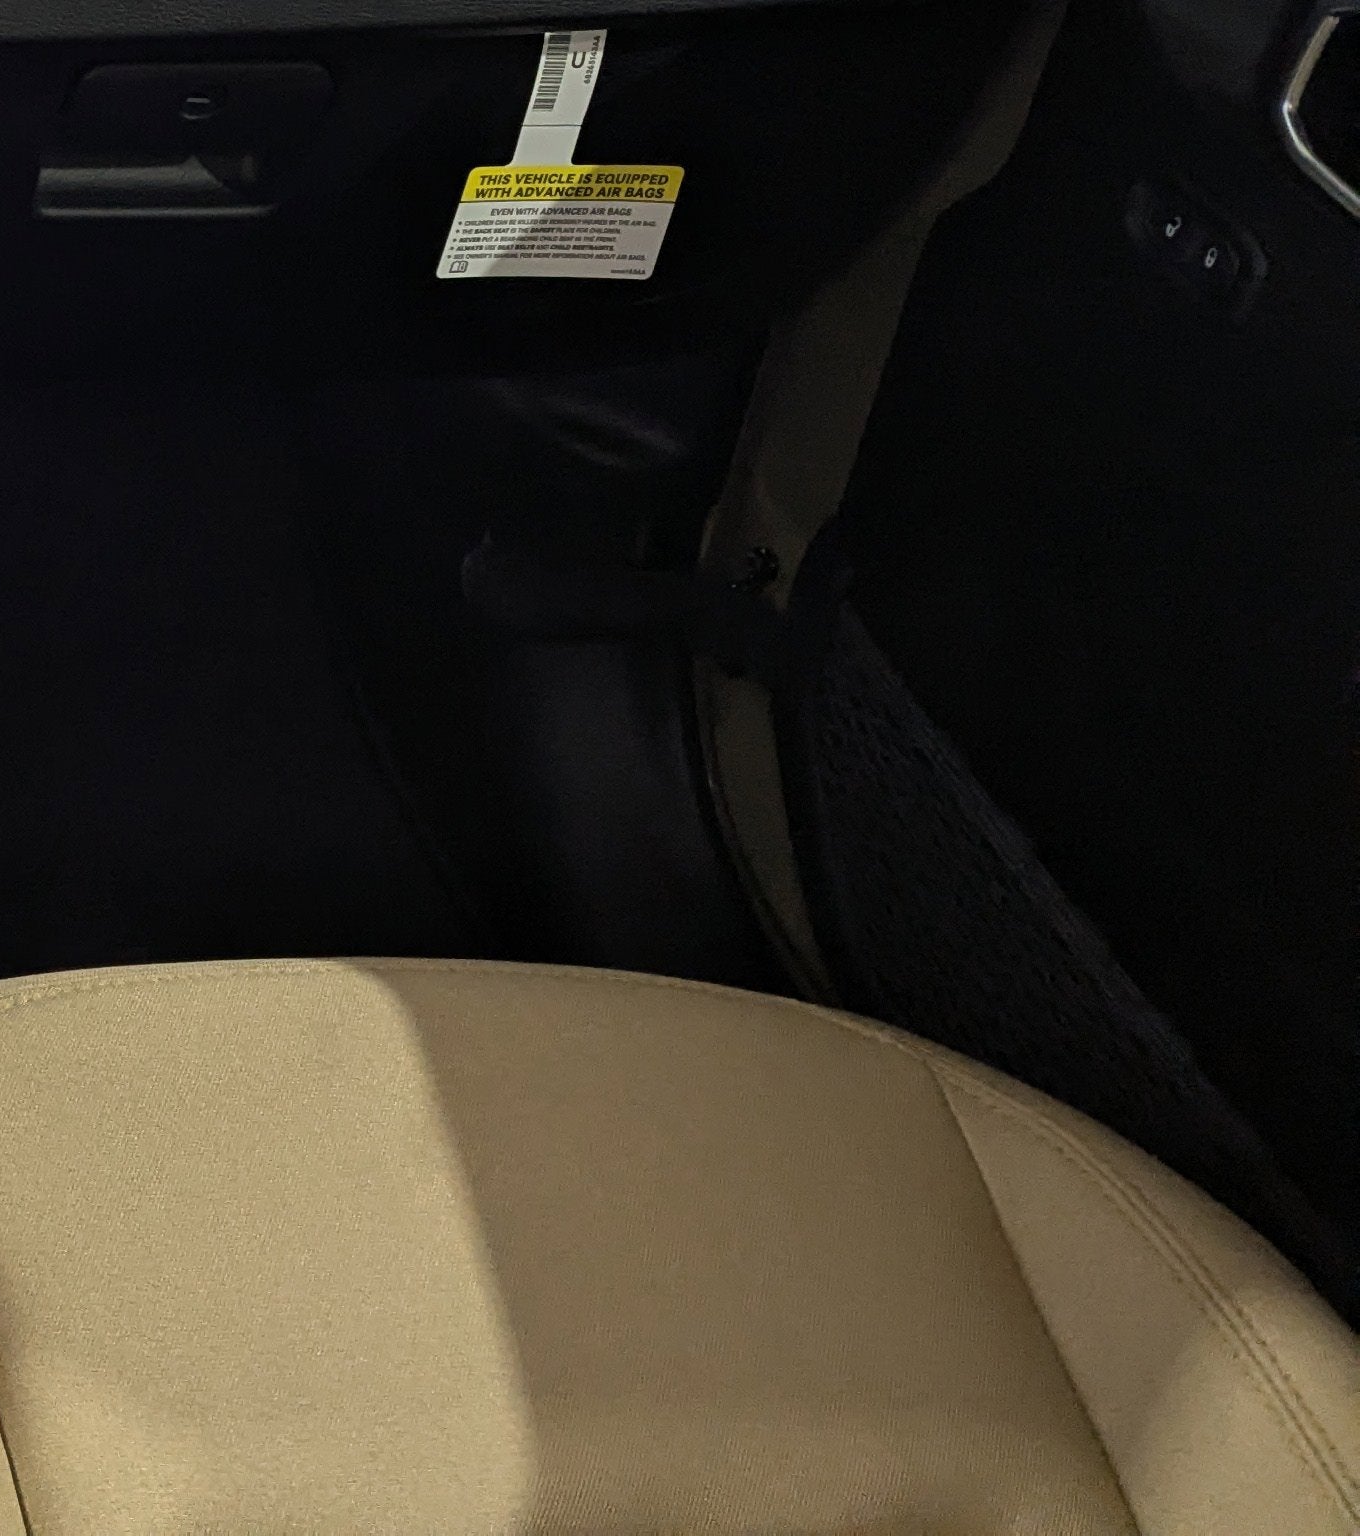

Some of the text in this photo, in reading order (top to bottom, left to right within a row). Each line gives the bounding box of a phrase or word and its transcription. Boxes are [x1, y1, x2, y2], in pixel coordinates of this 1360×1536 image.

[479, 173, 669, 186] THIS VEHICLE IS EQUIPPED
[475, 187, 665, 199] WITH ADVANCED AIR BAGS
[490, 208, 514, 216] EVEN
[516, 208, 538, 216] WITH
[540, 208, 589, 216] ADVANCED
[591, 208, 606, 216] AIR
